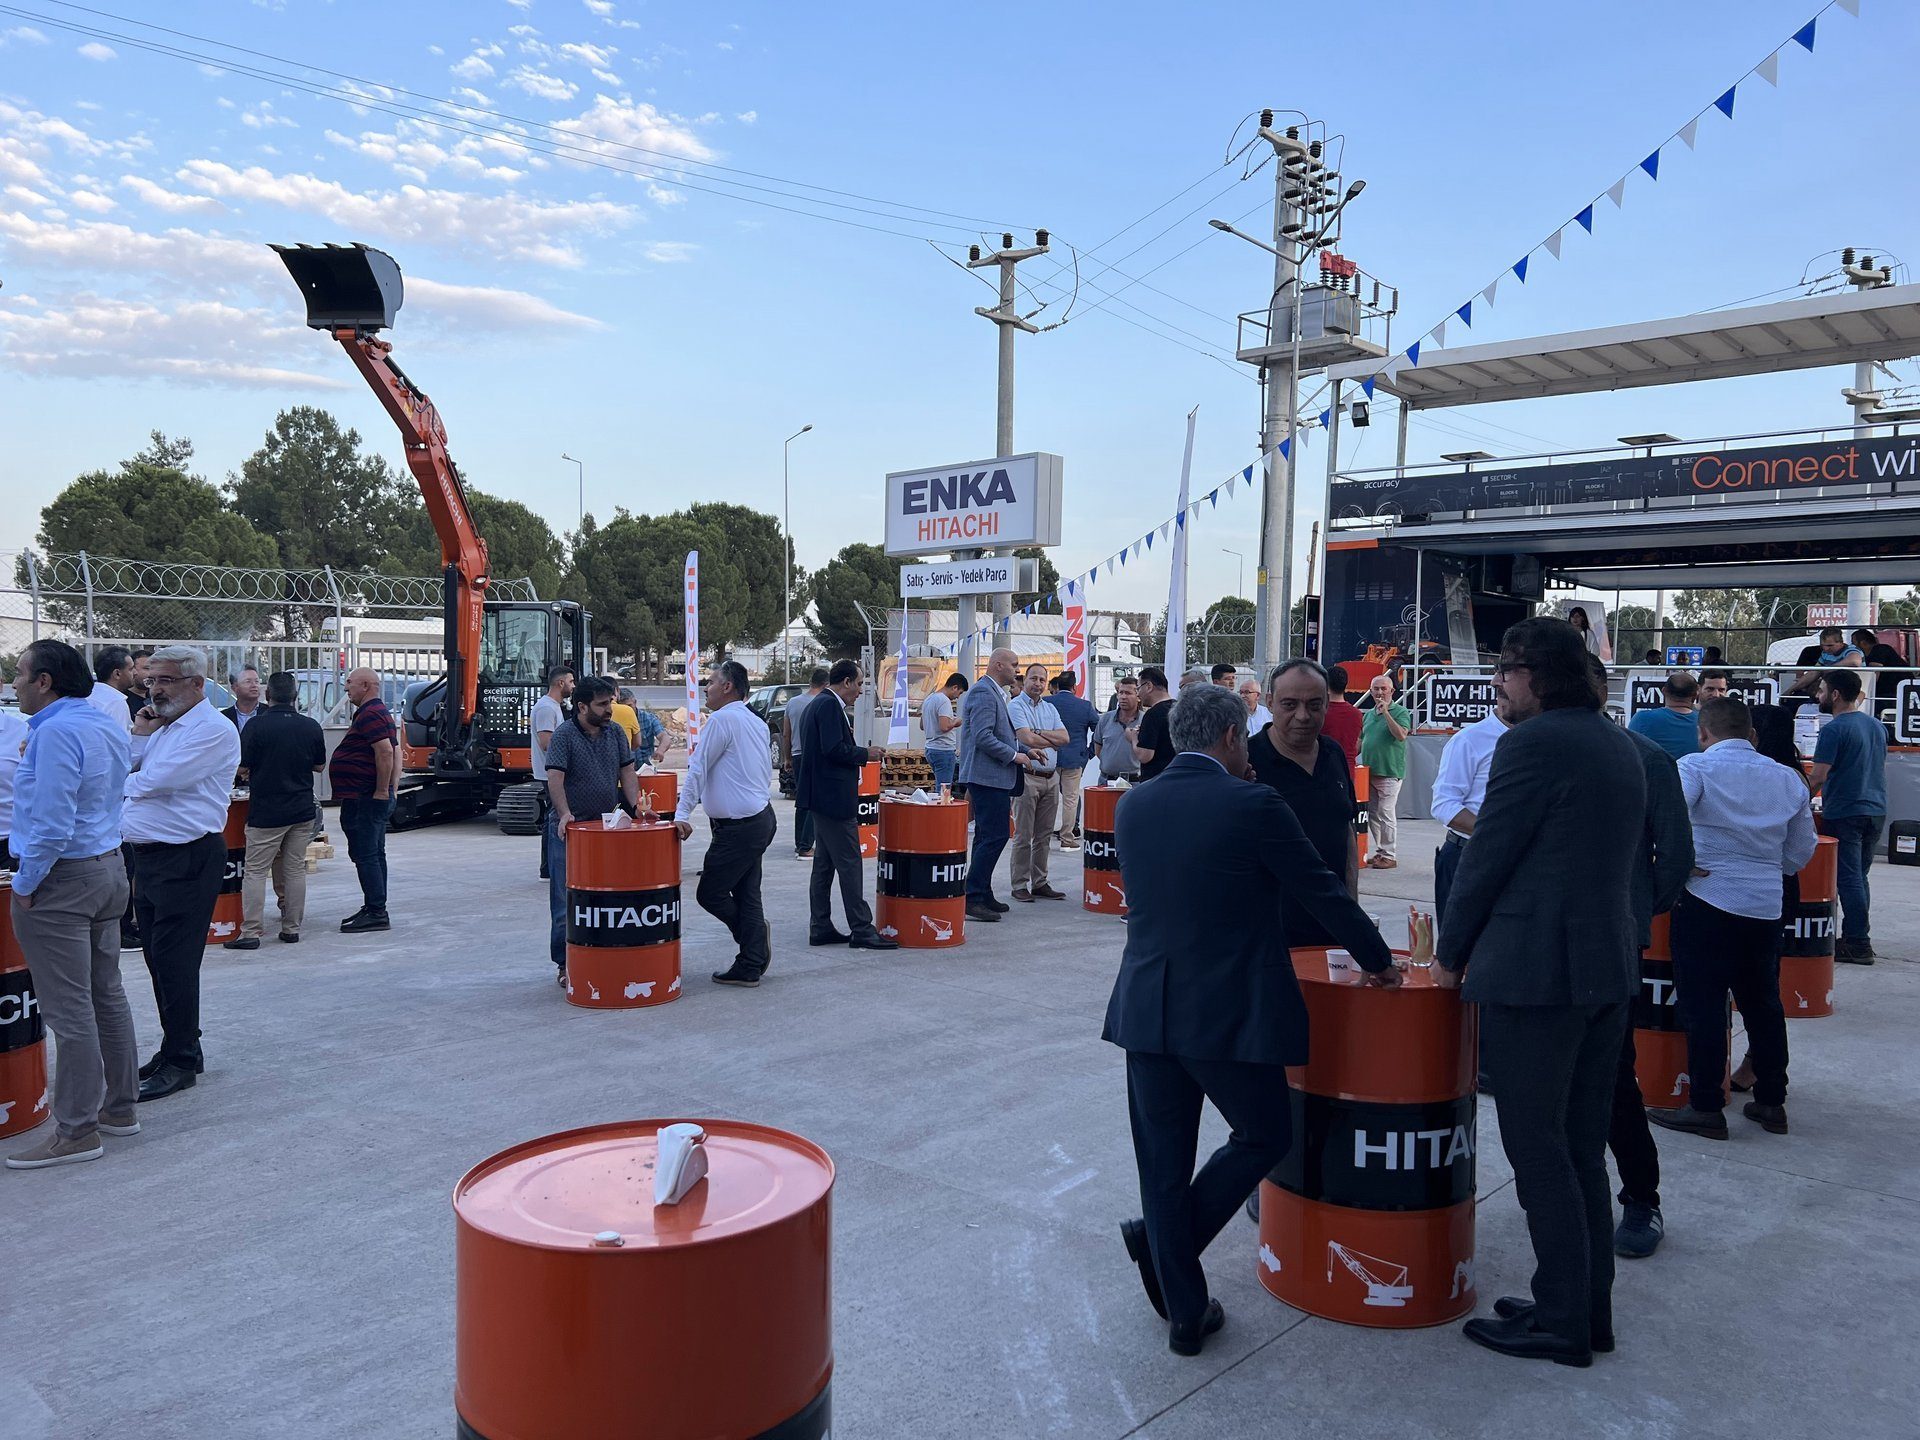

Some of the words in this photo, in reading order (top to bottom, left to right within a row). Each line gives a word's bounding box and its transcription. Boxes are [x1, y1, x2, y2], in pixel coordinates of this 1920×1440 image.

[1692, 447, 1860, 489] Connect
[1871, 440, 1920, 477] wi
[1364, 479, 1400, 489] accuracy
[1490, 474, 1518, 482] SECTOR-C
[440, 472, 463, 526] HITACHI
[903, 469, 1016, 515] ENKA
[918, 512, 998, 541] HITACHI
[907, 573, 924, 588] Satış
[931, 571, 953, 586] Servis
[961, 568, 984, 583] Yedek
[985, 567, 1007, 582] Parça
[483, 687, 519, 695] excellent
[483, 695, 519, 704] efficiency
[1435, 684, 1464, 699] MY
[1469, 684, 1498, 700] HIT
[1636, 686, 1665, 704] MY
[1435, 703, 1498, 718] EXPER
[1352, 810, 1369, 824] TA
[1083, 840, 1118, 857] ACH
[575, 900, 680, 929] HITACHI
[1354, 1124, 1476, 1170] HITA
